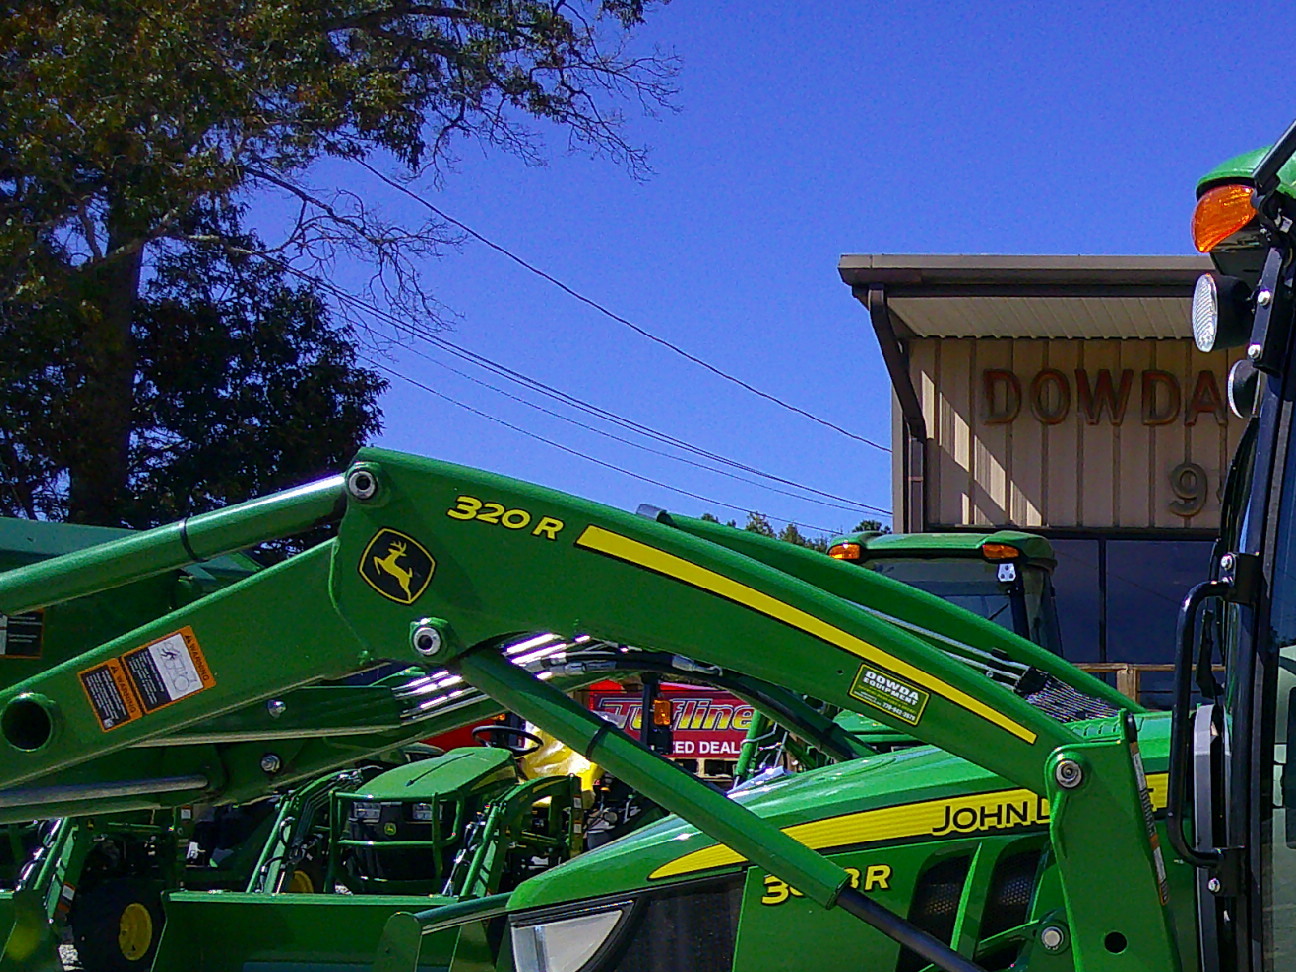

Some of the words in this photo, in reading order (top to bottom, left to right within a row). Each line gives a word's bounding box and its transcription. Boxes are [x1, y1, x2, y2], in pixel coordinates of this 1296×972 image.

[983, 368, 1228, 426] DOWDA
[446, 495, 532, 529] 320
[531, 516, 565, 540] R
[188, 643, 210, 681] WARNING
[863, 677, 918, 705] EQUIPMENT
[865, 671, 919, 700] DOWDA
[699, 741, 743, 754] DEAL
[932, 801, 1029, 833] JOHN
